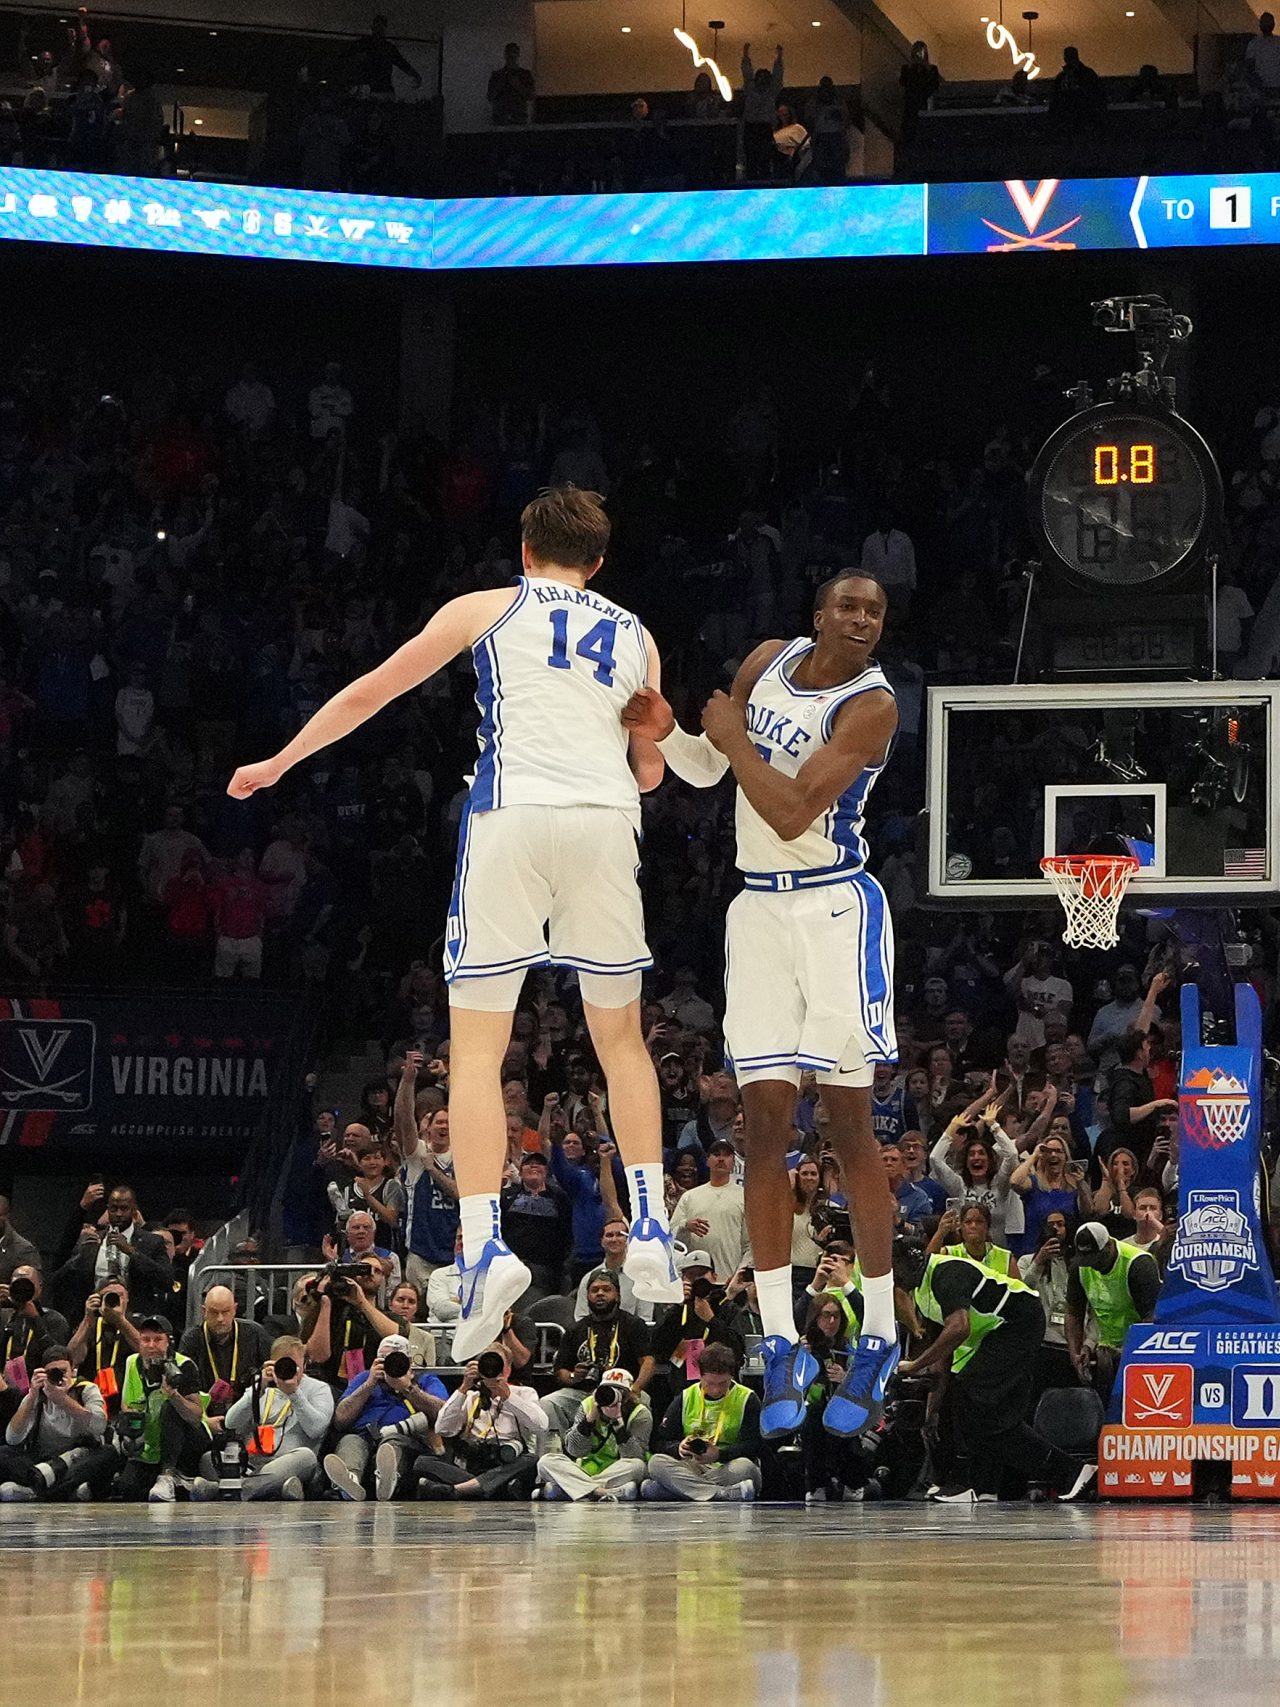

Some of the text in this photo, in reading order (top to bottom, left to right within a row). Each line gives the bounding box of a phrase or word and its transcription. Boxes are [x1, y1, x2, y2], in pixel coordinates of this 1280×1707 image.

[1161, 193, 1238, 223] TO 1
[1094, 445, 1154, 484] 0.8
[532, 586, 633, 630] KHAMENIA
[547, 608, 618, 688] 14
[746, 703, 812, 758] DUKE
[110, 1055, 269, 1097] VIRGINIA
[872, 1114, 899, 1134] UKE
[1203, 1215, 1227, 1224] ACC
[1134, 1331, 1201, 1354] ACC
[1204, 1388, 1221, 1403] VS
[1102, 1435, 1259, 1461] CHAMPIONSHIP
